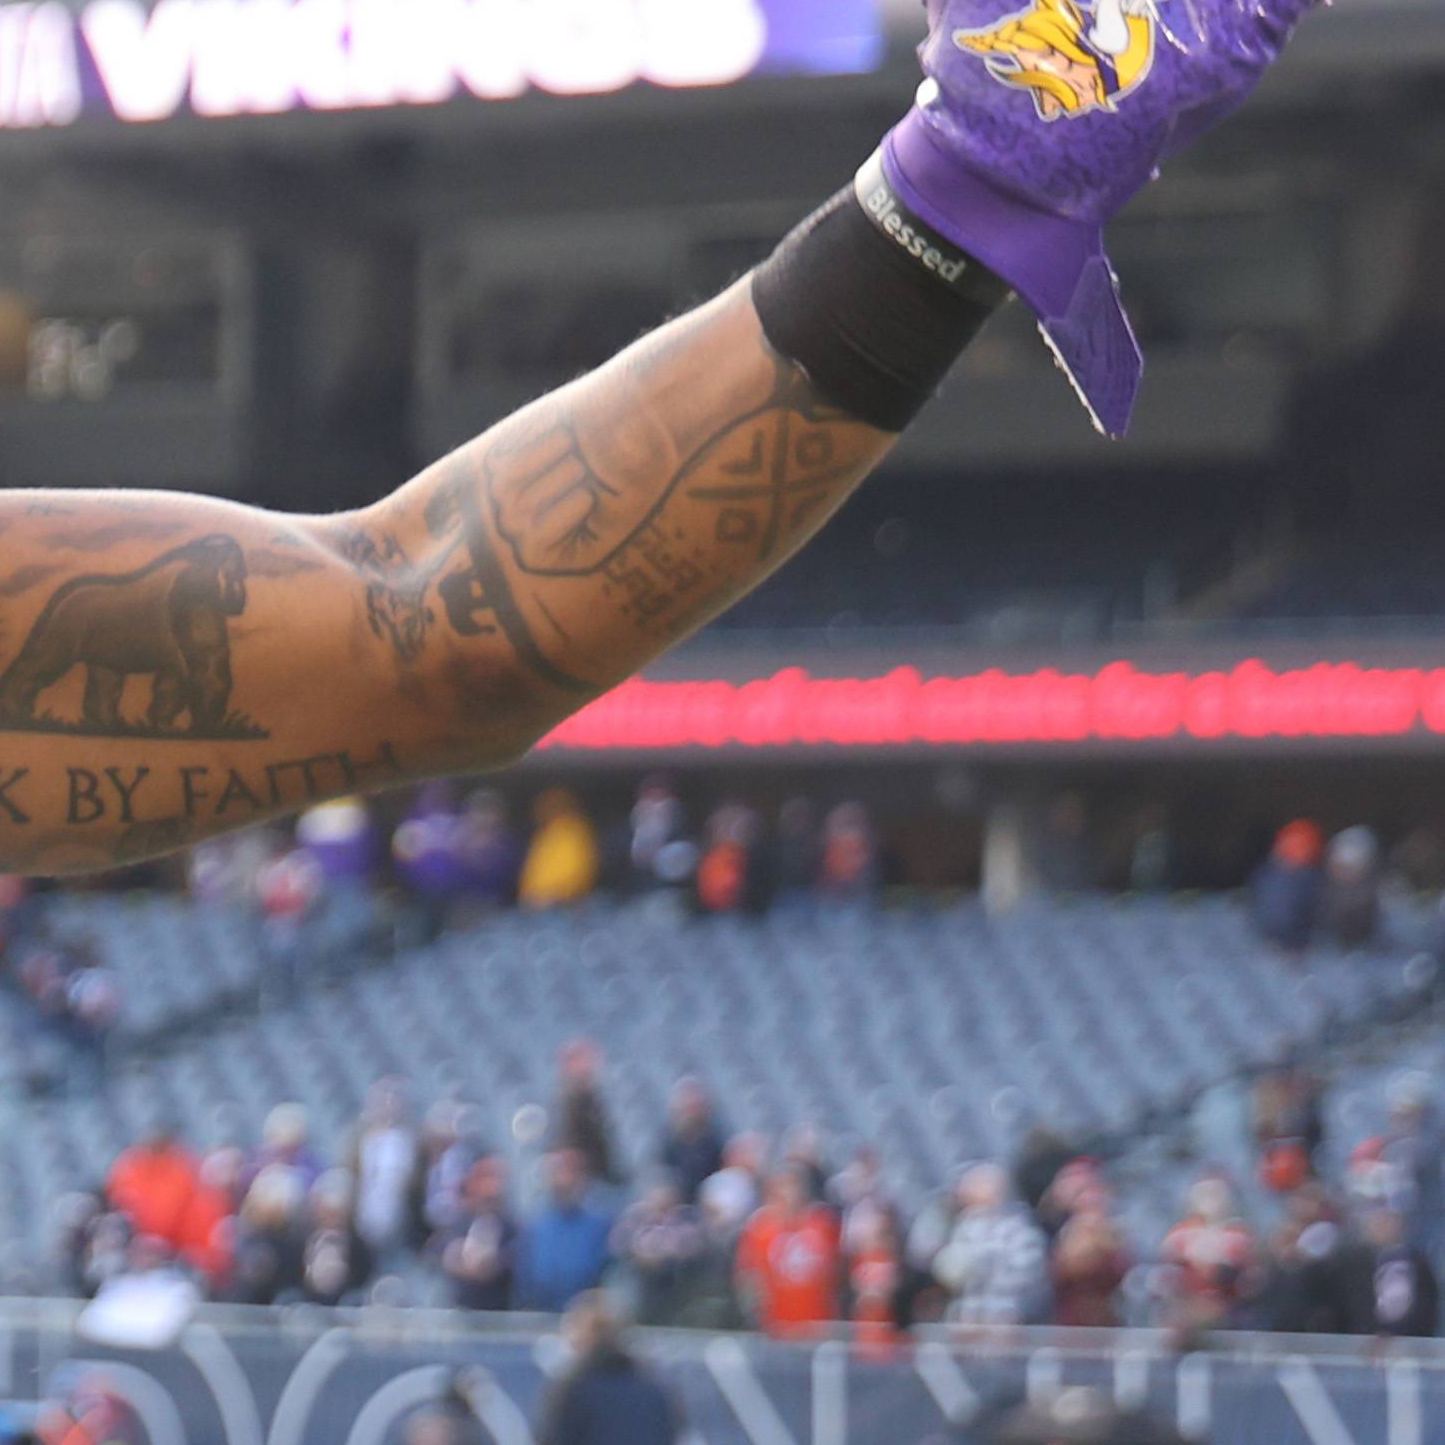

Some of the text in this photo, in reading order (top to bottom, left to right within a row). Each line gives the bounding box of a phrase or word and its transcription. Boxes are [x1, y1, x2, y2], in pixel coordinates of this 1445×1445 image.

[865, 186, 967, 283] Blessed
[65, 763, 151, 825] BY
[179, 739, 400, 818] FAITH
